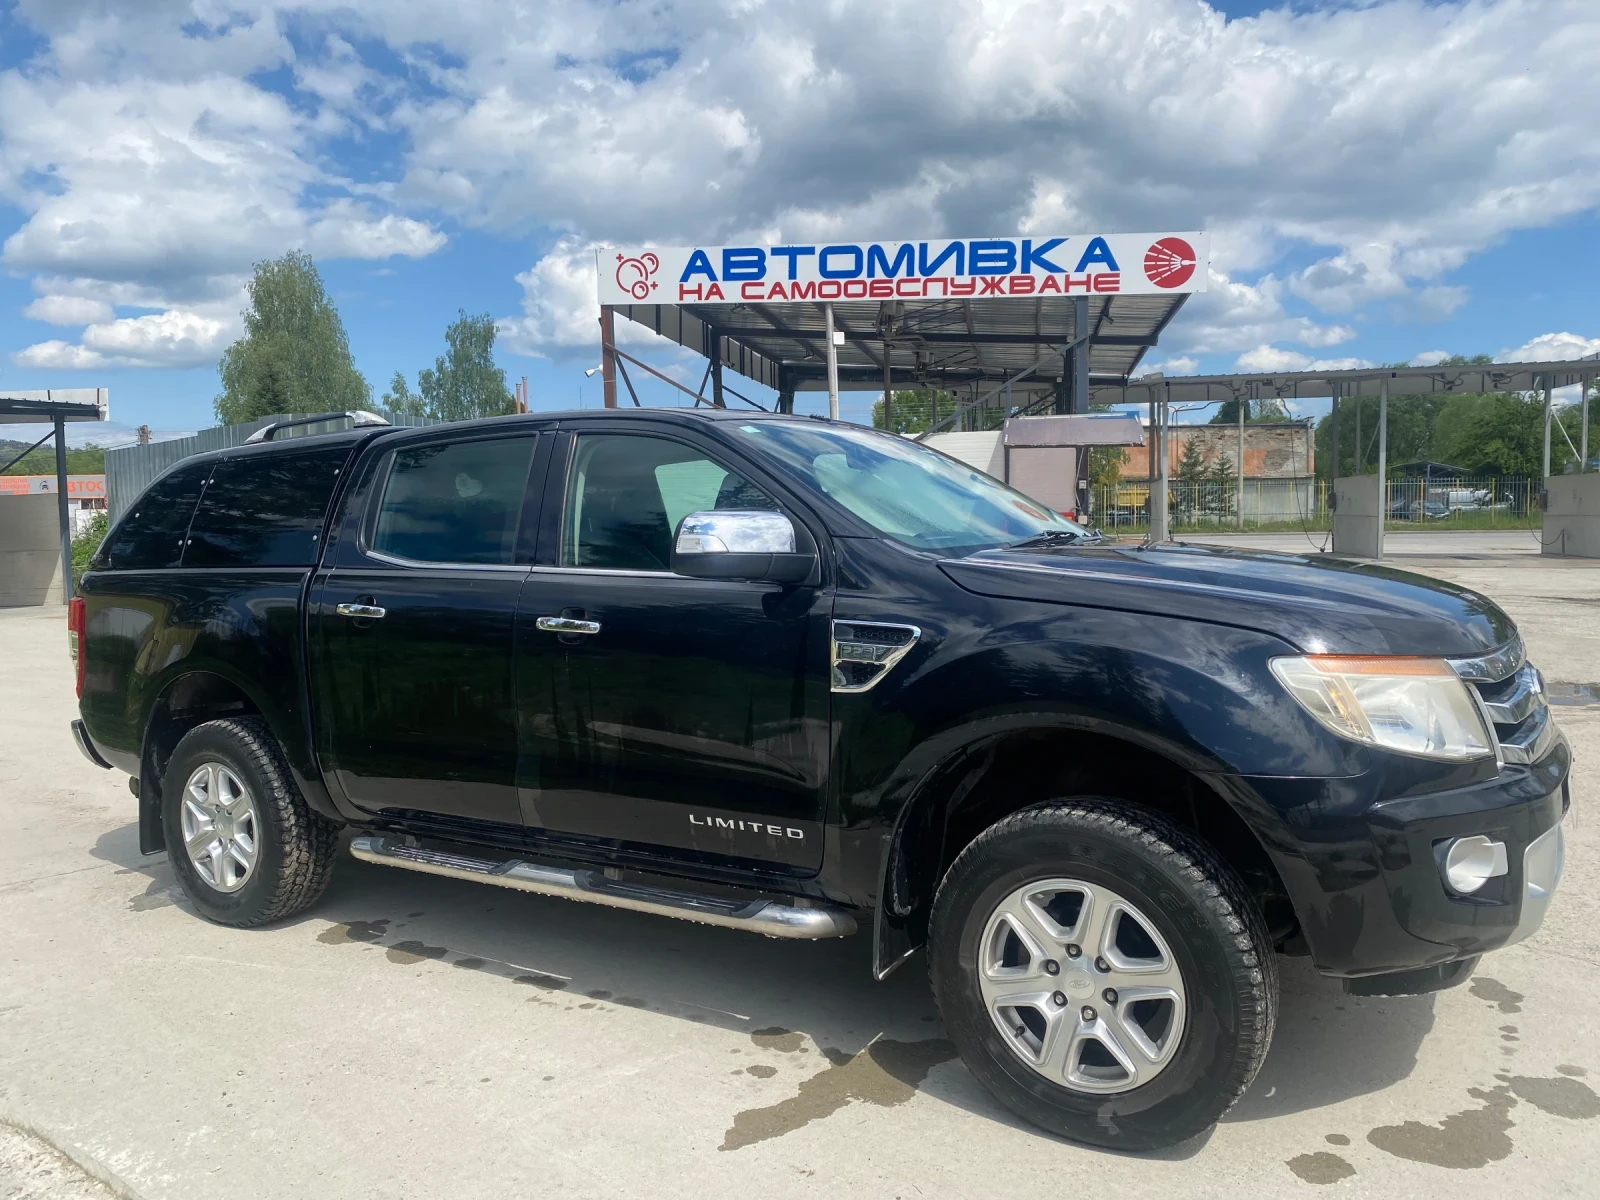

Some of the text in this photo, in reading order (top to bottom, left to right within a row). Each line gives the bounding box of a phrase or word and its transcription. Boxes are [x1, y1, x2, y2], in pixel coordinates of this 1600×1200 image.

[679, 236, 1119, 283] АВТОМИВКА
[679, 283, 725, 301] НА
[688, 813, 804, 839] LIMITED
